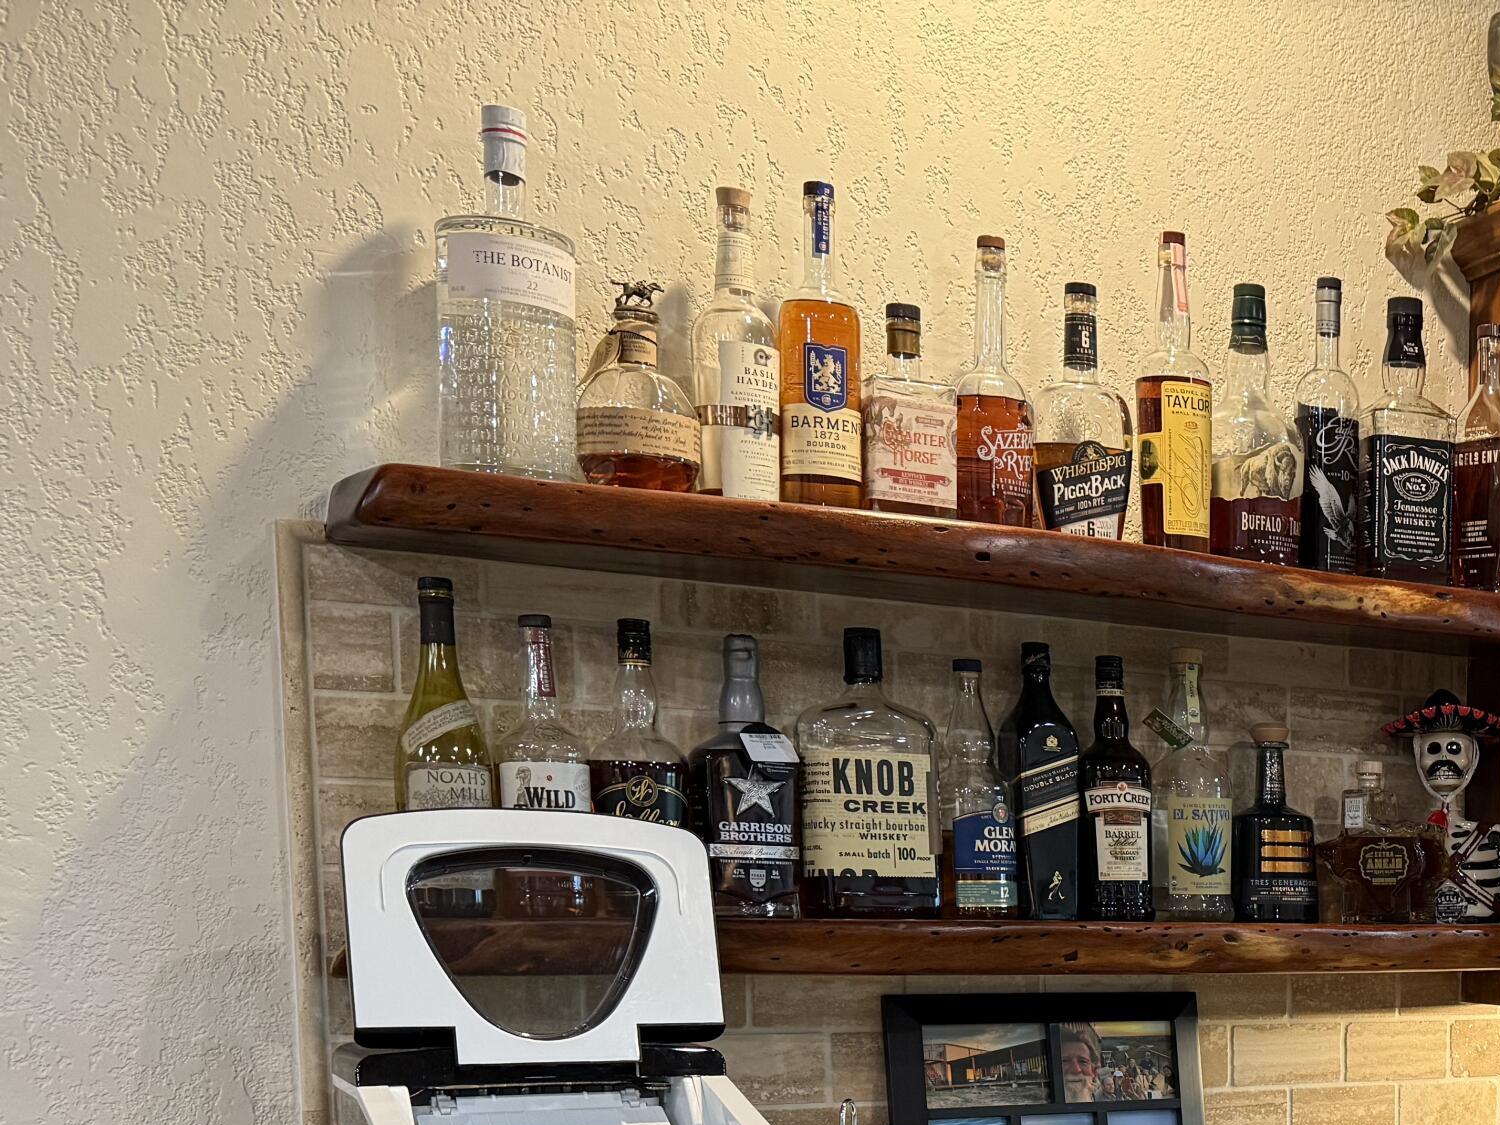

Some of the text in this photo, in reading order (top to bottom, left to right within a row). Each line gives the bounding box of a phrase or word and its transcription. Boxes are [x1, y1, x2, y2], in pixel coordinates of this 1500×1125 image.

[472, 250, 573, 285] THE BOTANIST
[526, 280, 538, 291] 22
[1081, 331, 1090, 348] 6
[744, 366, 775, 380] BASIL
[736, 376, 778, 392] HAYDEN
[1164, 388, 1198, 396] COLONEL
[1165, 394, 1210, 413] TAYLOR
[791, 415, 859, 436] BARMEN
[814, 430, 840, 440] 1873
[806, 440, 847, 450] BOURBON
[977, 424, 1034, 461] SAZERA
[893, 448, 938, 467] HORSE
[1050, 455, 1126, 482] WHISTLEPIG
[1382, 450, 1450, 482] JACK DANIEL'S
[1341, 469, 1350, 481] 10
[1053, 474, 1126, 506] PIGGYBACK
[1405, 482, 1427, 492] No.7
[1092, 496, 1105, 508] RYE
[1394, 500, 1438, 514] Tennessee
[1087, 520, 1096, 537] 6
[1168, 519, 1192, 528] BOTTLED
[1241, 511, 1282, 532] BUFFALO
[1394, 516, 1437, 528] WHISKEY
[426, 770, 486, 786] NOAH'S
[832, 758, 914, 796] KNOB
[1024, 770, 1078, 792] DOUBLE BLACK
[449, 786, 486, 801] MILL
[524, 786, 576, 808] WILD
[1089, 792, 1150, 806] FORTY CREEK
[844, 800, 926, 814] CREEK
[1172, 808, 1230, 823] EL SATIVO
[718, 821, 792, 834] GARRISON
[803, 817, 926, 833] entucky straight bourbon
[720, 832, 792, 843] BROTHERS
[859, 832, 908, 841] WHISKEY
[984, 826, 1015, 839] GLEN
[1104, 830, 1142, 839] BARREL
[867, 848, 891, 859] batch
[898, 847, 917, 861] 100
